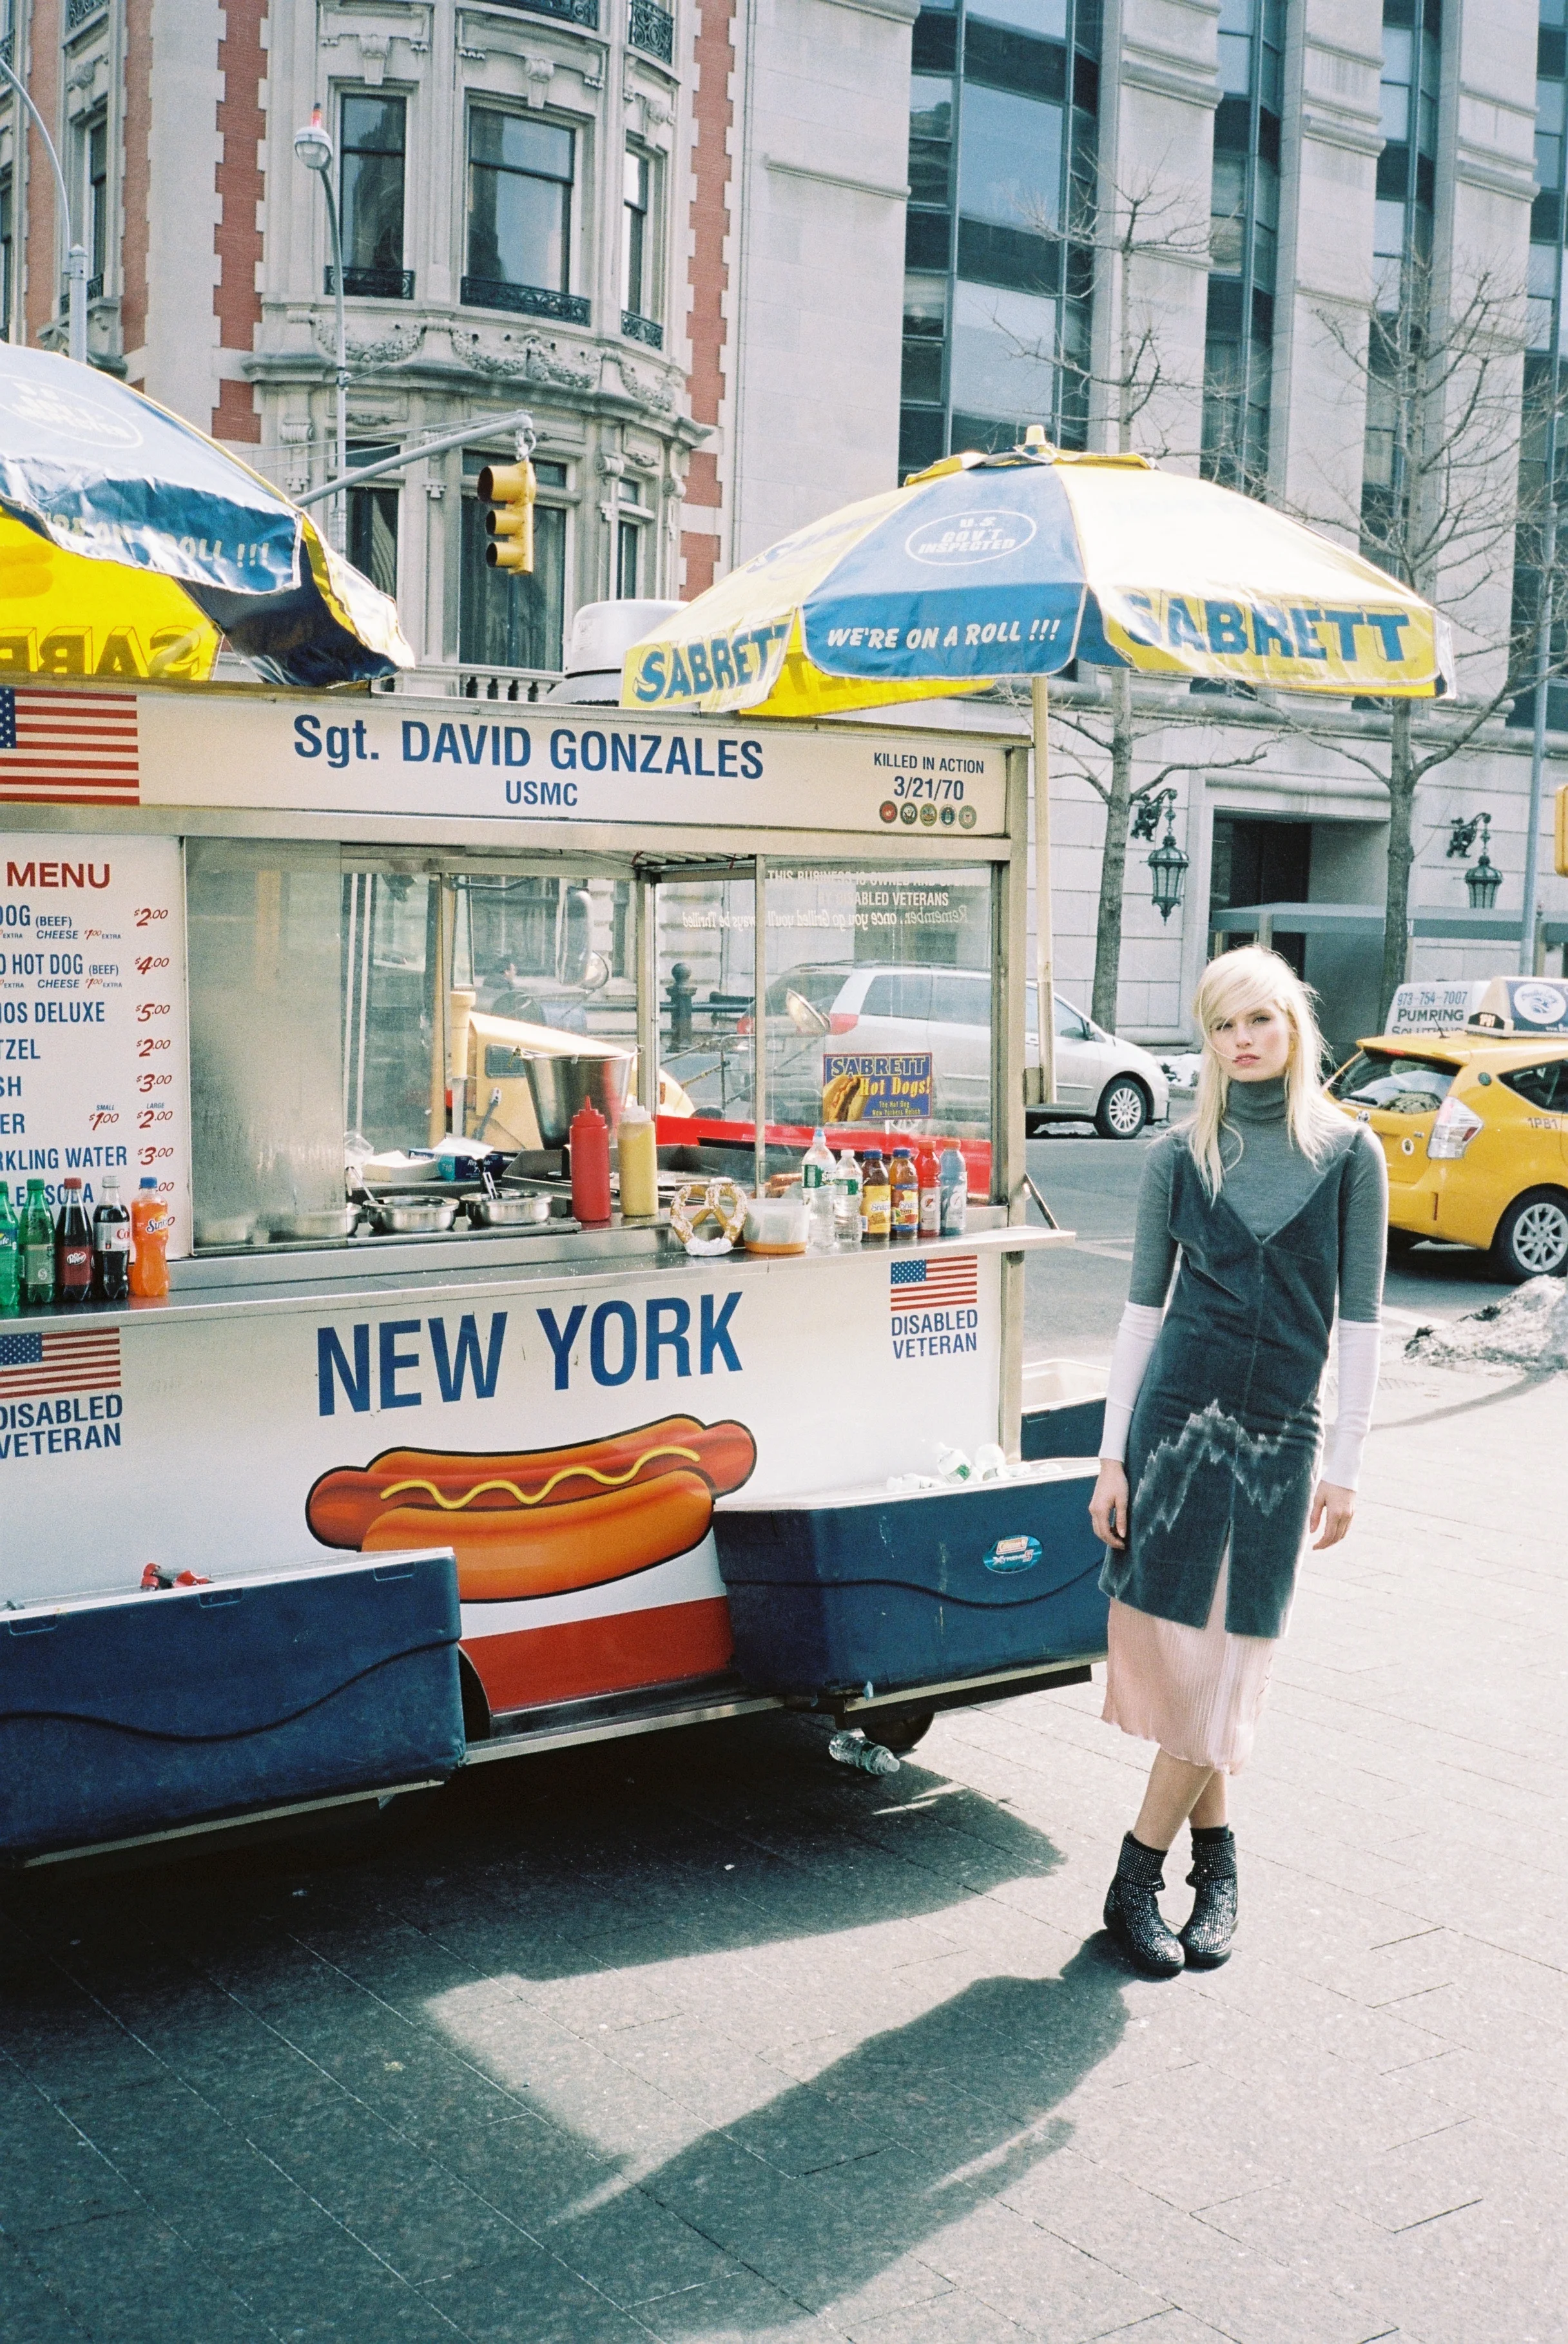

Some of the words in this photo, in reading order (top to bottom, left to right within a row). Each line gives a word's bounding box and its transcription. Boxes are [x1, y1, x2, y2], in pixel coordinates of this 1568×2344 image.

[918, 538, 1016, 554] INSPECTED
[828, 627, 900, 650] WE'RE
[906, 628, 940, 650] ON
[944, 625, 958, 647] A
[965, 621, 1021, 645] ROLL
[1029, 619, 1060, 641] !!!
[1120, 586, 1411, 663] SABRETT
[294, 714, 379, 768] Sgt.
[402, 721, 531, 766] DAVID
[550, 729, 764, 779] GONZALES
[874, 752, 917, 769] KILLED
[923, 757, 934, 770] IN
[939, 758, 984, 773] ACTION
[506, 780, 577, 806] USMC
[893, 775, 964, 801] 3/21/70
[6, 862, 110, 889] MENU
[768, 870, 793, 882] THIS
[893, 892, 949, 906] VETERANS
[35, 916, 72, 928] (BEEF)
[134, 908, 168, 927] $2.00
[36, 930, 79, 939] CHEESE
[12, 954, 44, 974] HOT
[50, 954, 83, 975] DOG
[89, 965, 119, 976] (BEEF)
[135, 956, 169, 974] $4.00
[37, 979, 79, 988] CHEESE
[0, 1002, 28, 1023] OS
[35, 1002, 105, 1022] DELUXE
[135, 1003, 170, 1022] $5.00
[1397, 1008, 1464, 1022] PUMPING
[137, 1038, 171, 1058] $2.00
[831, 1056, 926, 1076] SABRETT
[136, 1074, 172, 1092] $3.00
[859, 1077, 886, 1096] Hot
[891, 1076, 931, 1098] Dogs!
[89, 1112, 119, 1130] $1.00
[137, 1110, 173, 1128] $2.00
[65, 1146, 127, 1168] WATER
[137, 1147, 173, 1165] $3.00
[891, 1309, 978, 1337] DISABLED
[317, 1312, 508, 1416] NEW
[536, 1291, 744, 1391] YORK
[893, 1332, 977, 1359] VETERAN
[0, 1422, 121, 1459] VETERAN
